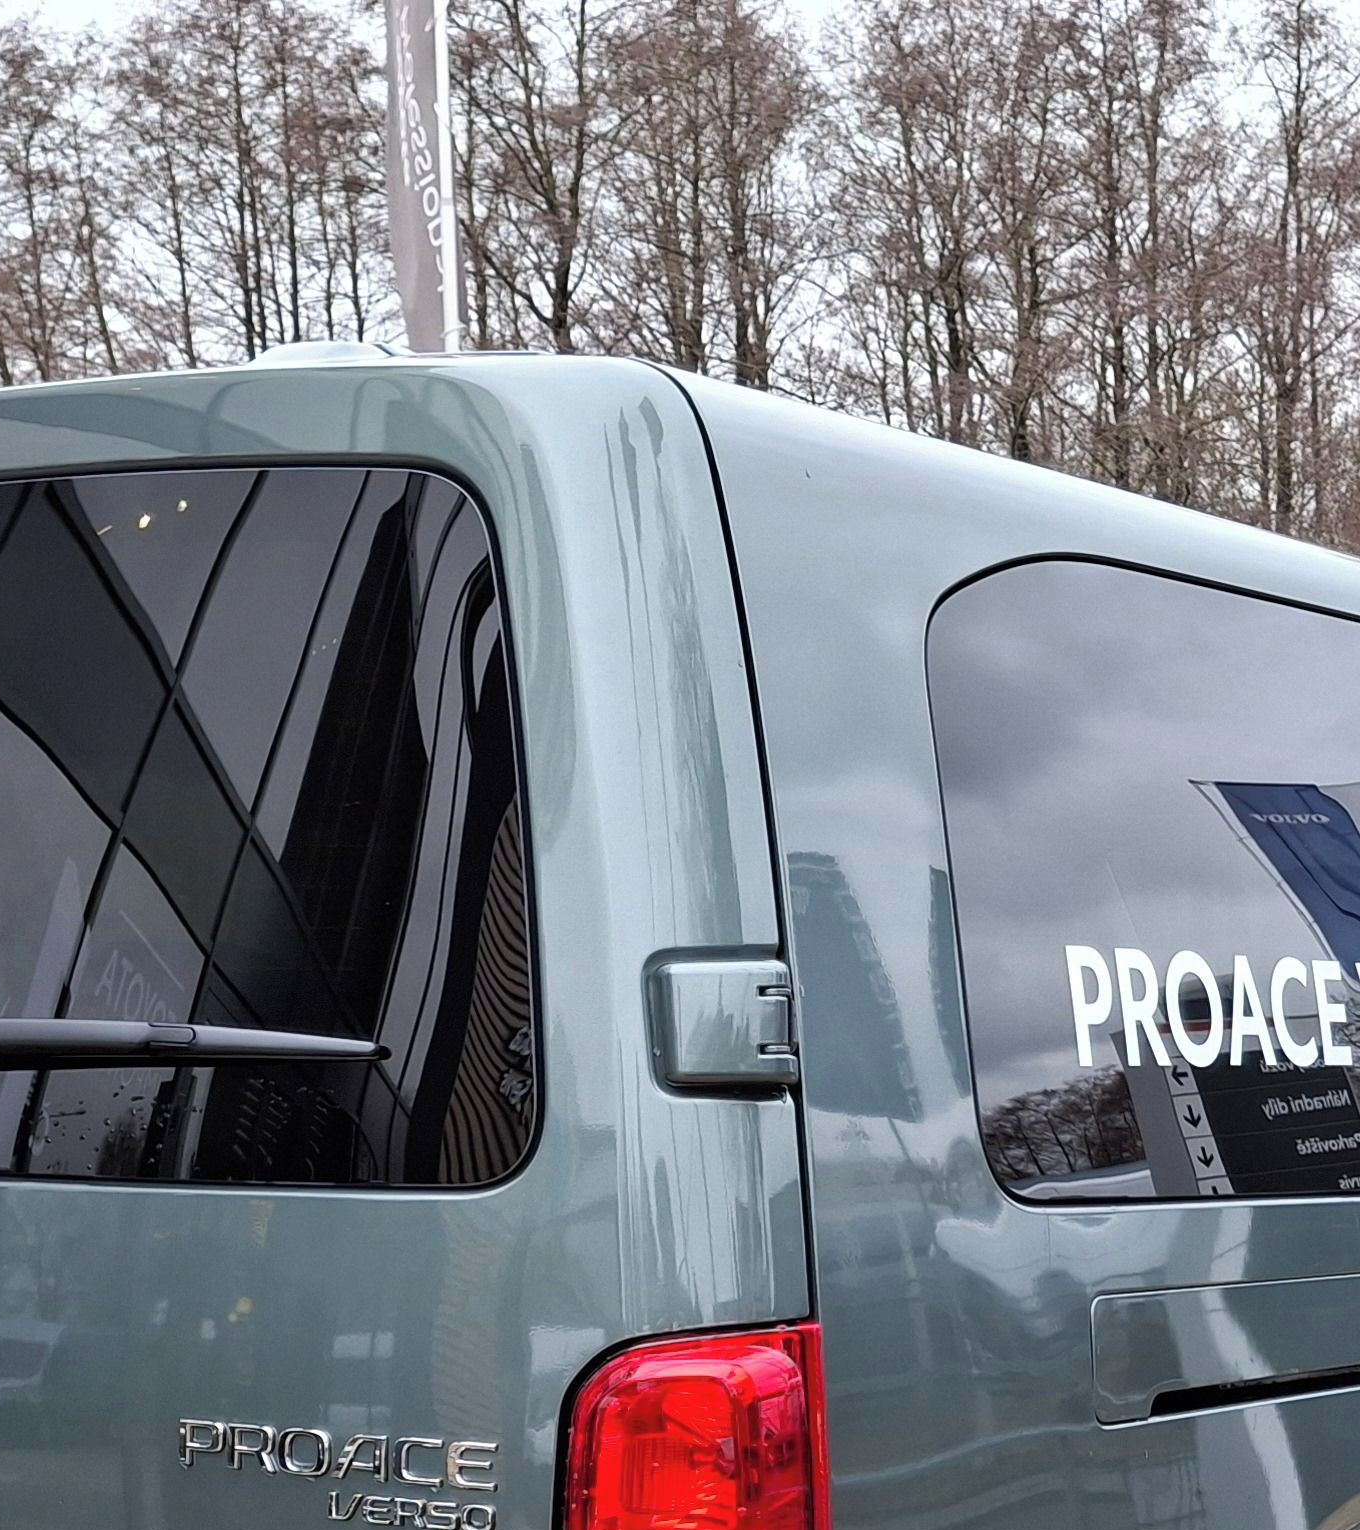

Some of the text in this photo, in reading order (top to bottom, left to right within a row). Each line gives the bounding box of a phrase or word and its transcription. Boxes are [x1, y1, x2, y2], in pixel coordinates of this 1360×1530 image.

[1249, 813, 1331, 825] VOLVO
[1064, 943, 1352, 1070] PROACE
[178, 1417, 499, 1493] PROACE
